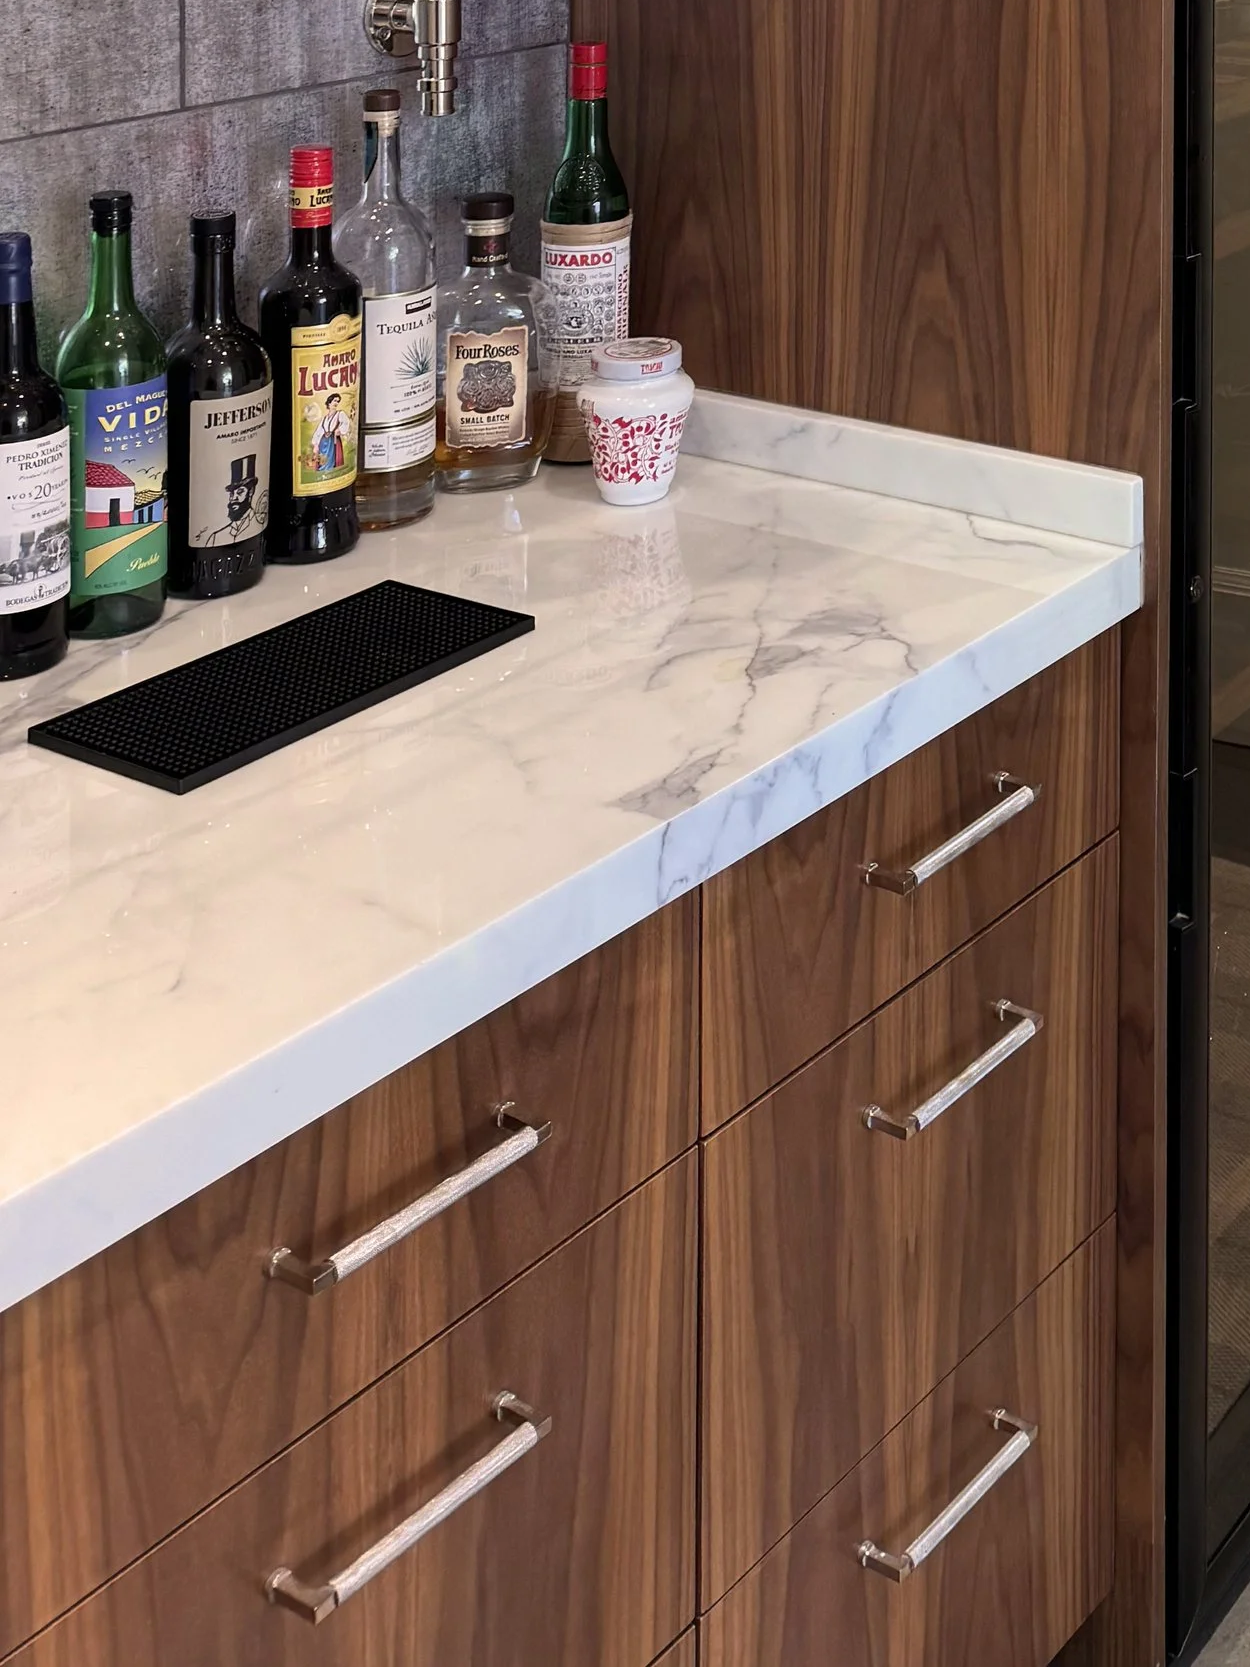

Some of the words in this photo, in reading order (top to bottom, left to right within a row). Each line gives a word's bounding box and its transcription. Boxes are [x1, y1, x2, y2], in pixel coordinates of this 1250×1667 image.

[545, 251, 613, 267] LUXARDO
[376, 320, 424, 335] TEQUILA
[323, 349, 356, 368] AMARO
[298, 362, 358, 396] LUCAN
[106, 401, 132, 413] DEL
[135, 390, 168, 404] MAGUE
[204, 398, 272, 429] JEFFERSON
[460, 416, 484, 425] SMALL
[486, 414, 510, 423] BATCH
[103, 432, 164, 453] MEZCA
[104, 432, 140, 443] SINGLE
[216, 431, 239, 440] AMARO
[231, 436, 247, 444] SINCE
[6, 451, 39, 463] PEDRO
[18, 452, 64, 471] TRADICION
[34, 482, 52, 501] 20
[6, 595, 37, 607] BODEGAS
